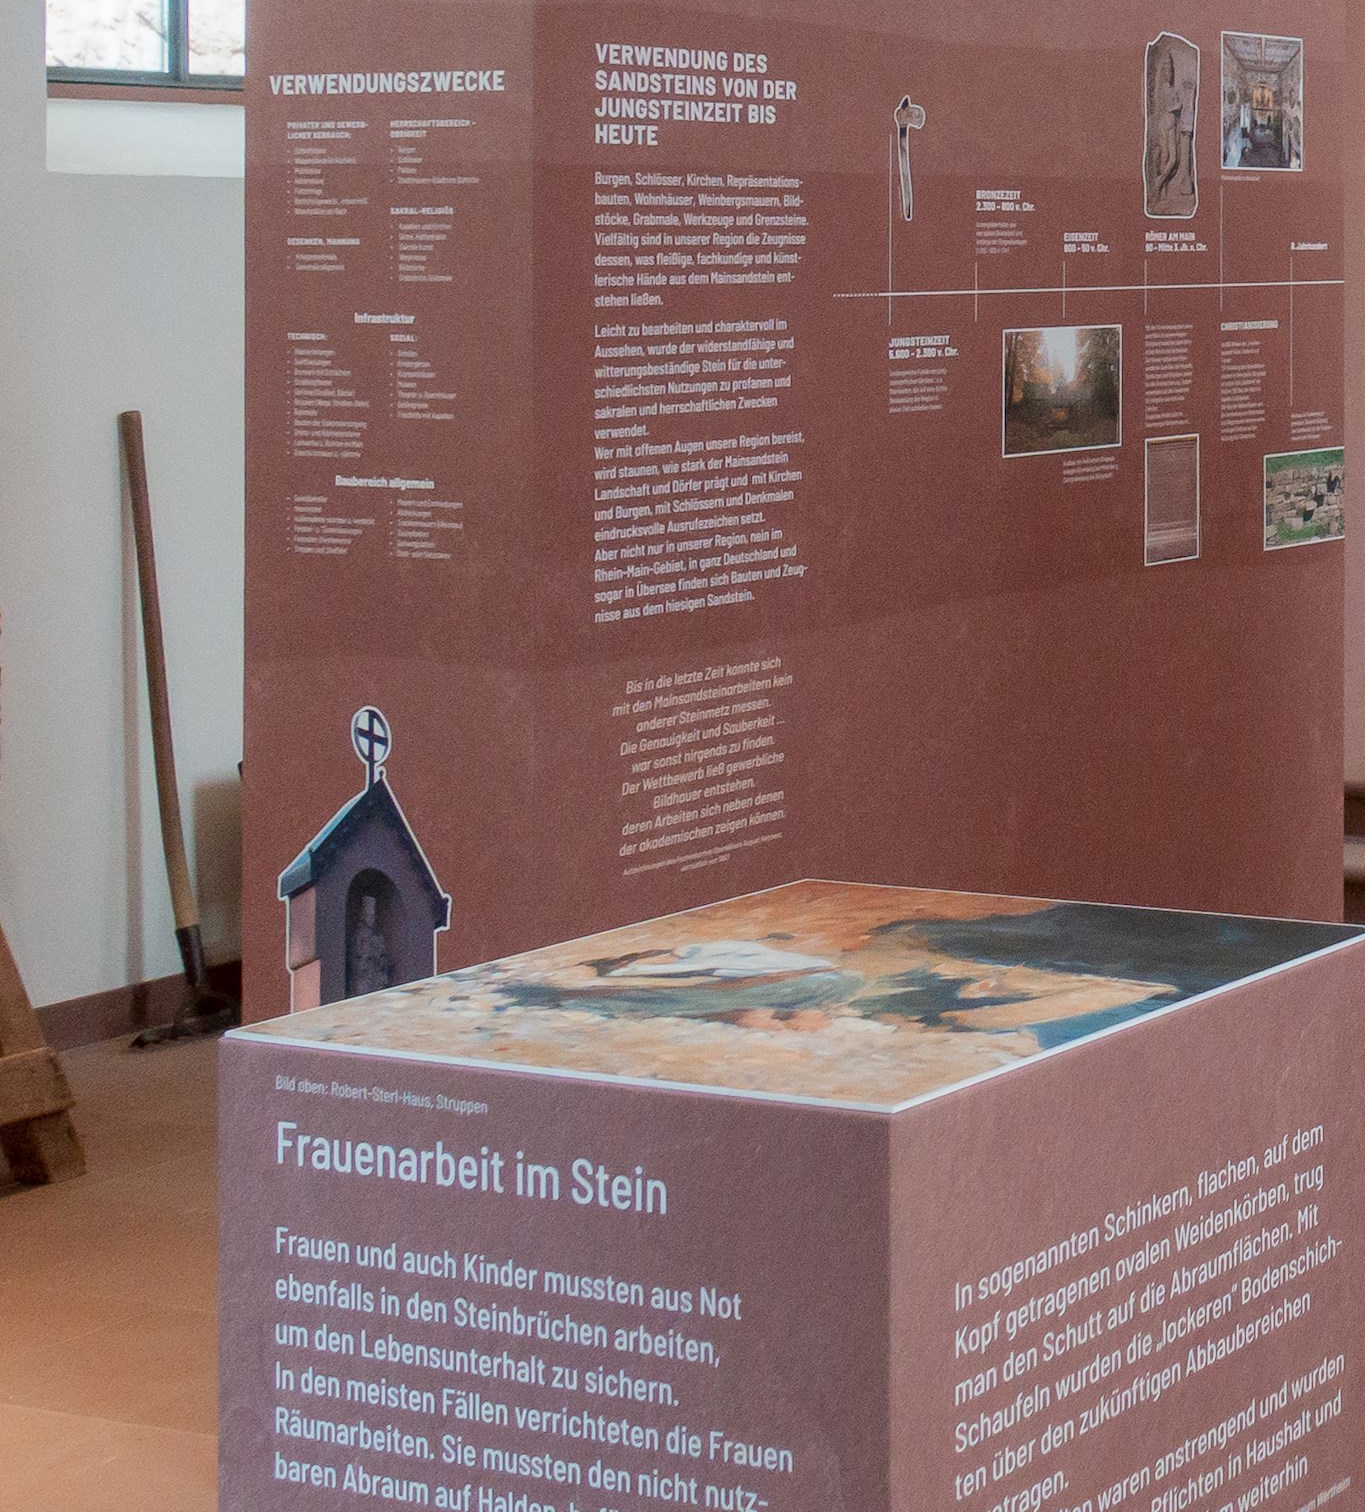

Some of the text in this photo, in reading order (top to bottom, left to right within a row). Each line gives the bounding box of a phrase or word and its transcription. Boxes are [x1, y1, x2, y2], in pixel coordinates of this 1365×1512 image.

[595, 42, 767, 73] VERWENDUNG DES
[268, 70, 504, 95] VERWENDUNGSZWECKE
[594, 69, 796, 100] SANDSTEINS VON DER
[594, 96, 775, 124] JUNGSTEINZEIT BIS
[595, 123, 658, 145] HEUTE
[594, 170, 803, 189] Burgen, Schlösser, Kirchen, Repräsentations-
[594, 191, 803, 209] bauten, Wohnhäuser, Weinbergsmauern, Bild-
[594, 212, 808, 228] stöcke, Grabmale, Werkzeuge und Grenzsteine.
[275, 1074, 295, 1091] Bild
[436, 1093, 488, 1115] Struppen
[277, 1120, 666, 1214] Frauenarbeit im Stein
[955, 1124, 1323, 1311] In sogenannten Schinkern, flachen, auf dem
[275, 1226, 741, 1320] Frauen und auch Kinder mussten aus Not
[954, 1164, 1323, 1359] Kopf getragenen ovalen Weidenkörben, trug
[275, 1273, 719, 1367] ebenfalls in den Steinbrüchen arbeiten,
[275, 1323, 678, 1406] um den Lebensunterhalt zu sichern.
[275, 1360, 792, 1472] In den meisten Fällen verrichteten die Frauen
